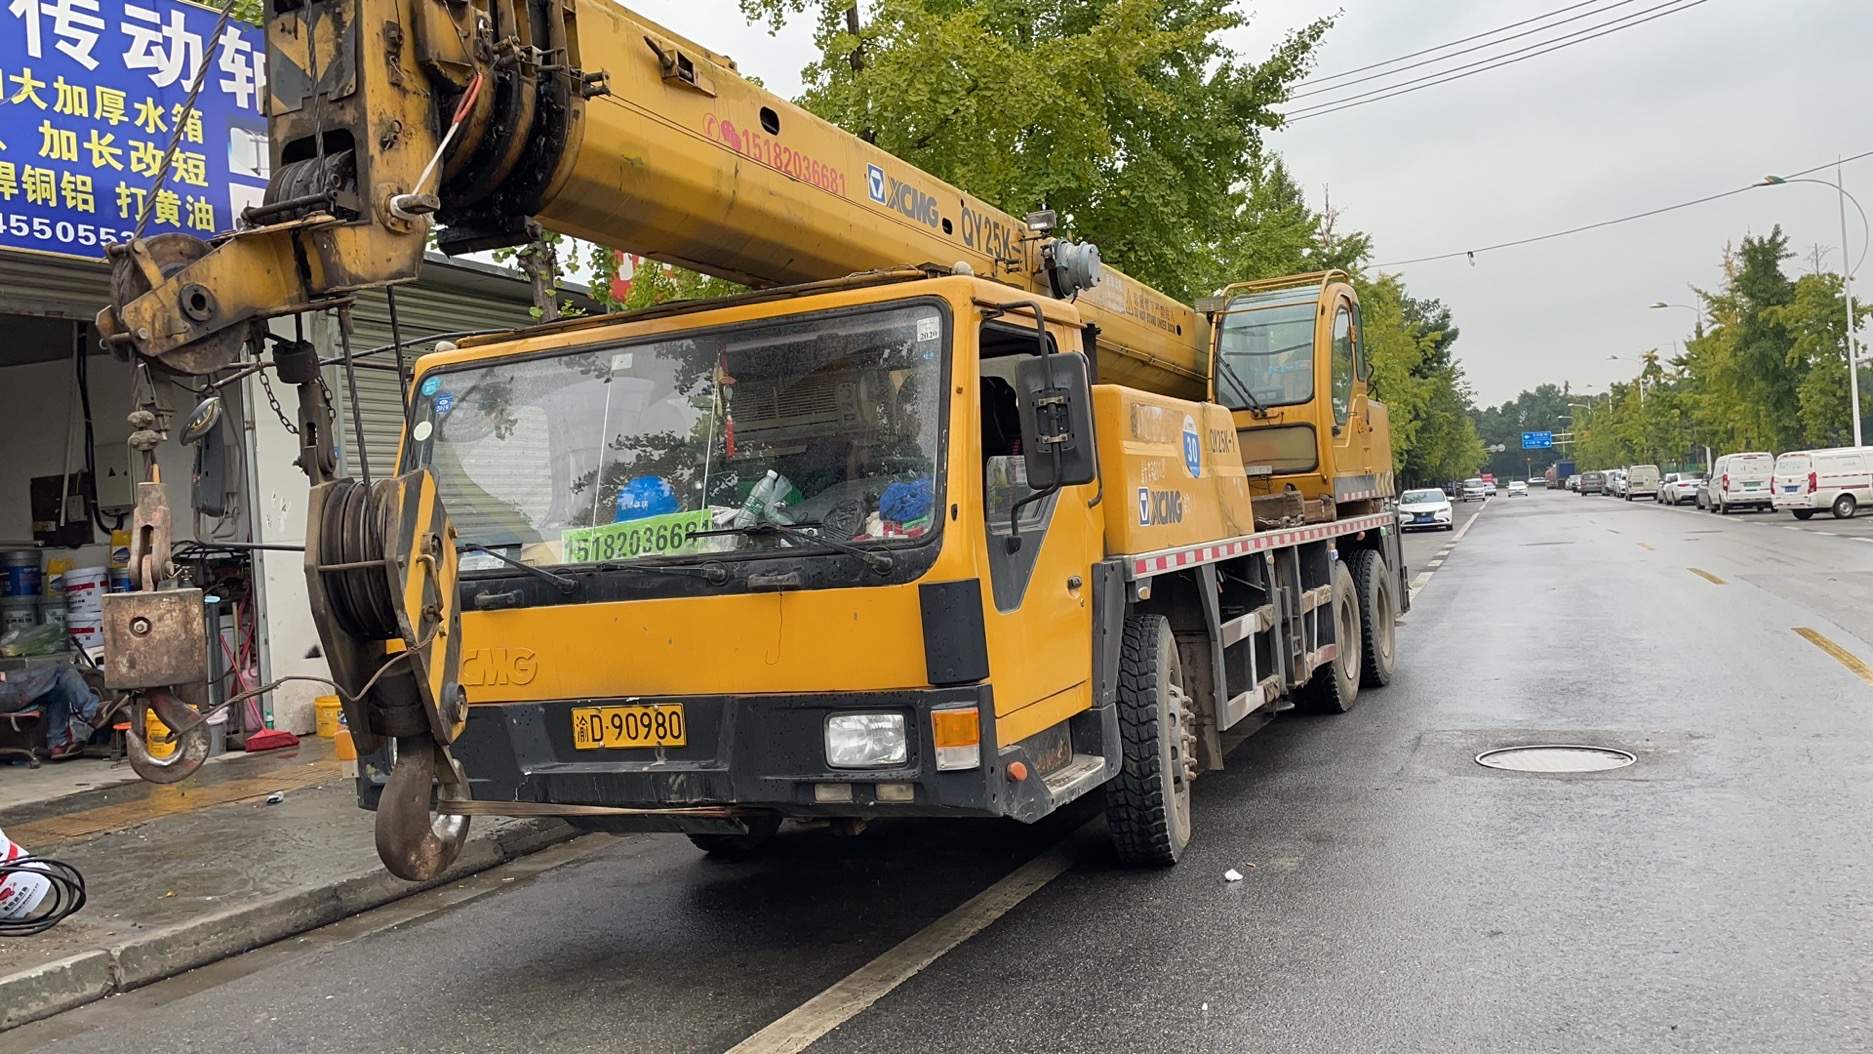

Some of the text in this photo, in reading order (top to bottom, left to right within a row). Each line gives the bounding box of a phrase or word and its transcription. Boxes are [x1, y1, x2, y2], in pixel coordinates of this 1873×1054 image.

[0, 67, 204, 144] 大加厚水箱
[38, 119, 209, 187] 加长改短
[742, 129, 846, 196] 15182036681
[115, 181, 215, 232] 打黄油
[886, 176, 938, 227] XCMG
[1186, 435, 1199, 463] 30
[1151, 490, 1183, 526] XCMG
[462, 648, 538, 687] CMG
